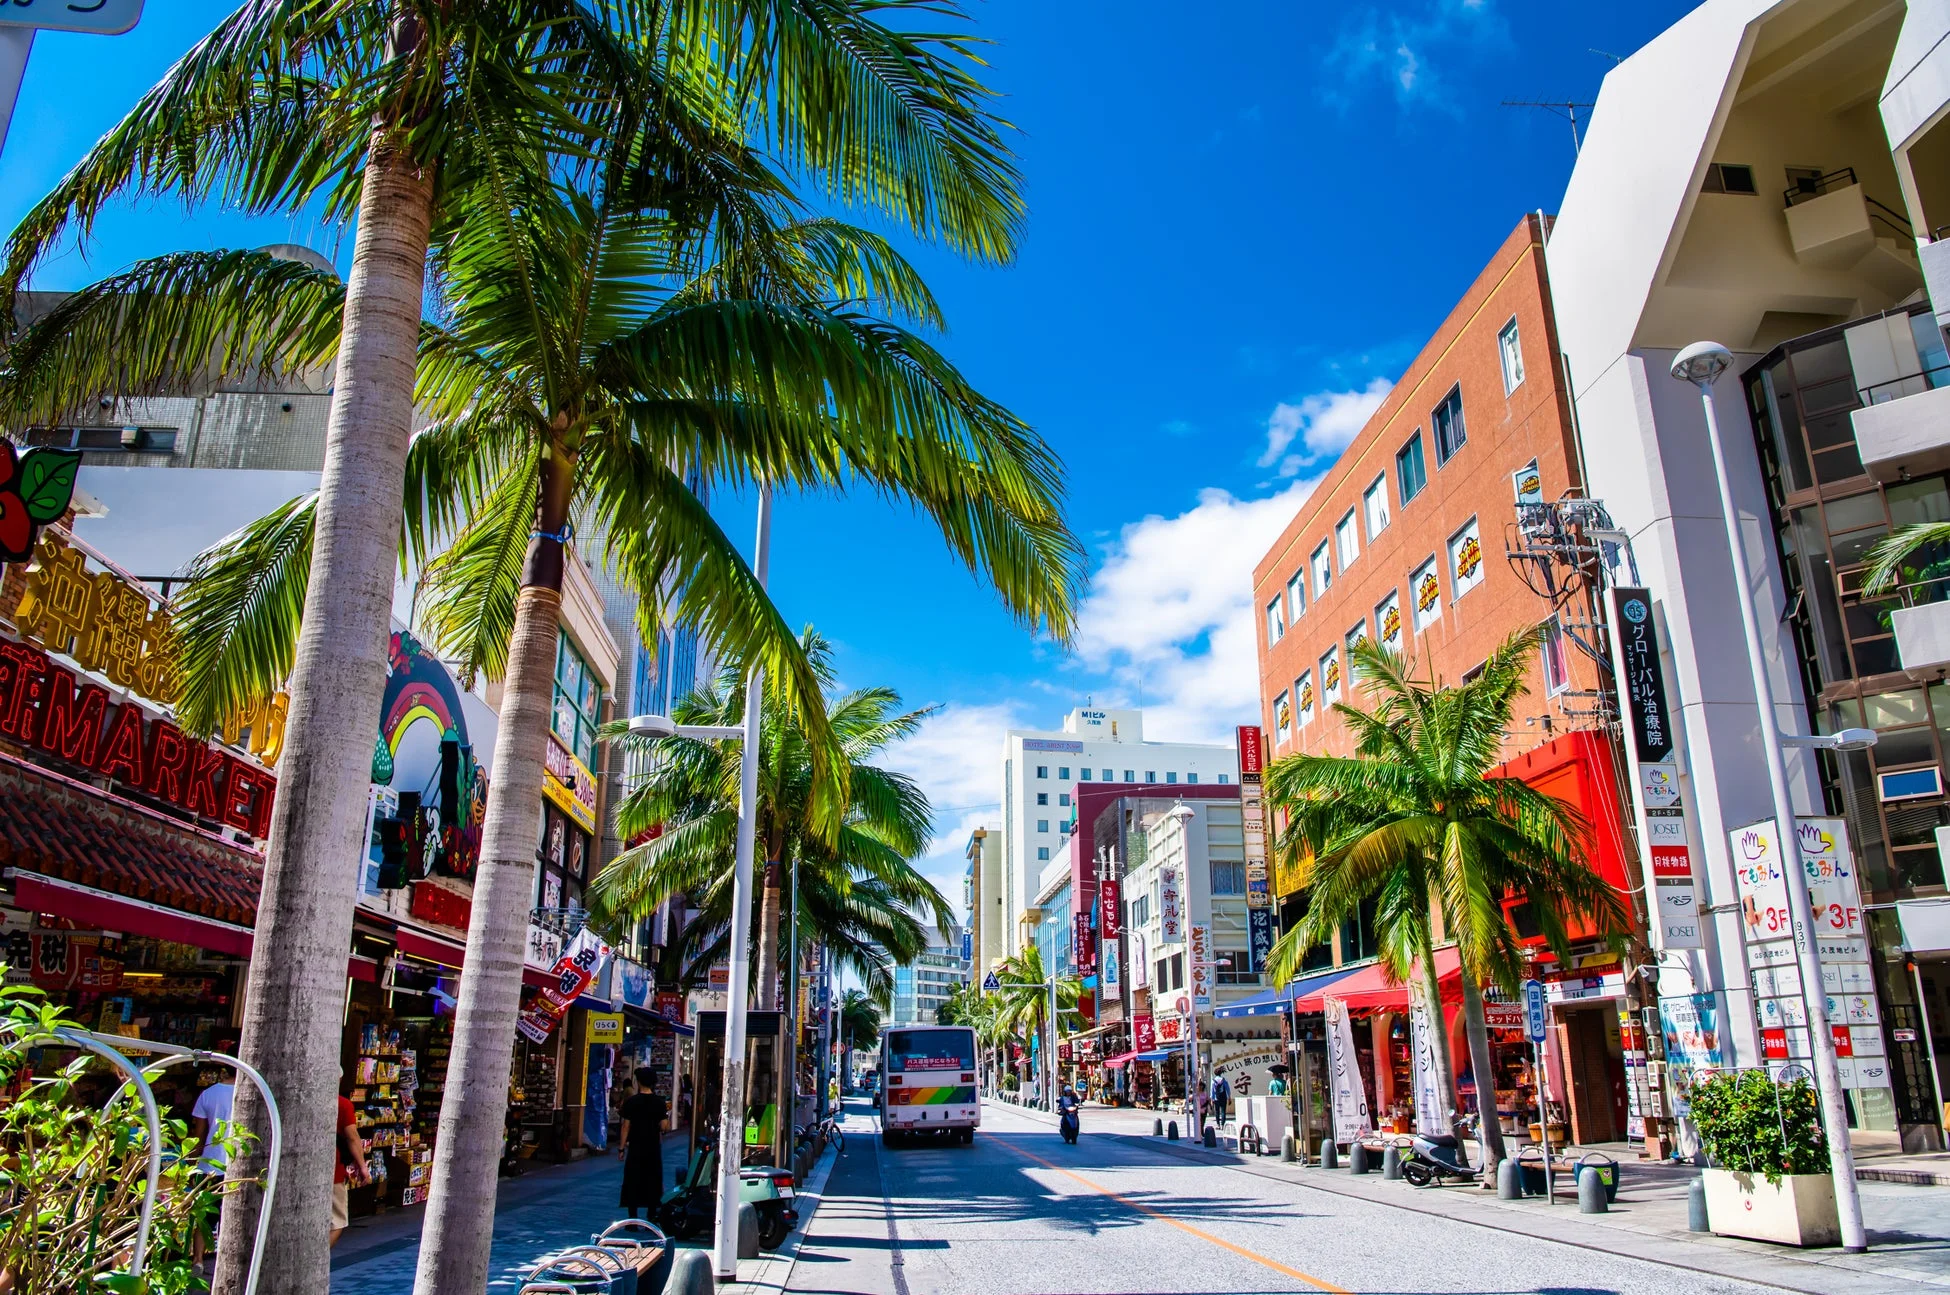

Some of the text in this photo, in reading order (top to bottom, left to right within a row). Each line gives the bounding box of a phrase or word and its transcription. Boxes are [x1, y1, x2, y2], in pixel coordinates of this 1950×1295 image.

[1632, 624, 1663, 746] グローバル治療院
[42, 660, 278, 840] MARKET
[1646, 786, 1676, 796] てもみん
[1655, 856, 1688, 868] 月桃物語
[1738, 863, 1779, 885] てもみん
[1766, 907, 1788, 932] 3F
[1829, 903, 1859, 930] 3F
[1820, 946, 1858, 955] 久茂地ビル
[1530, 991, 1542, 1032] 国際通り
